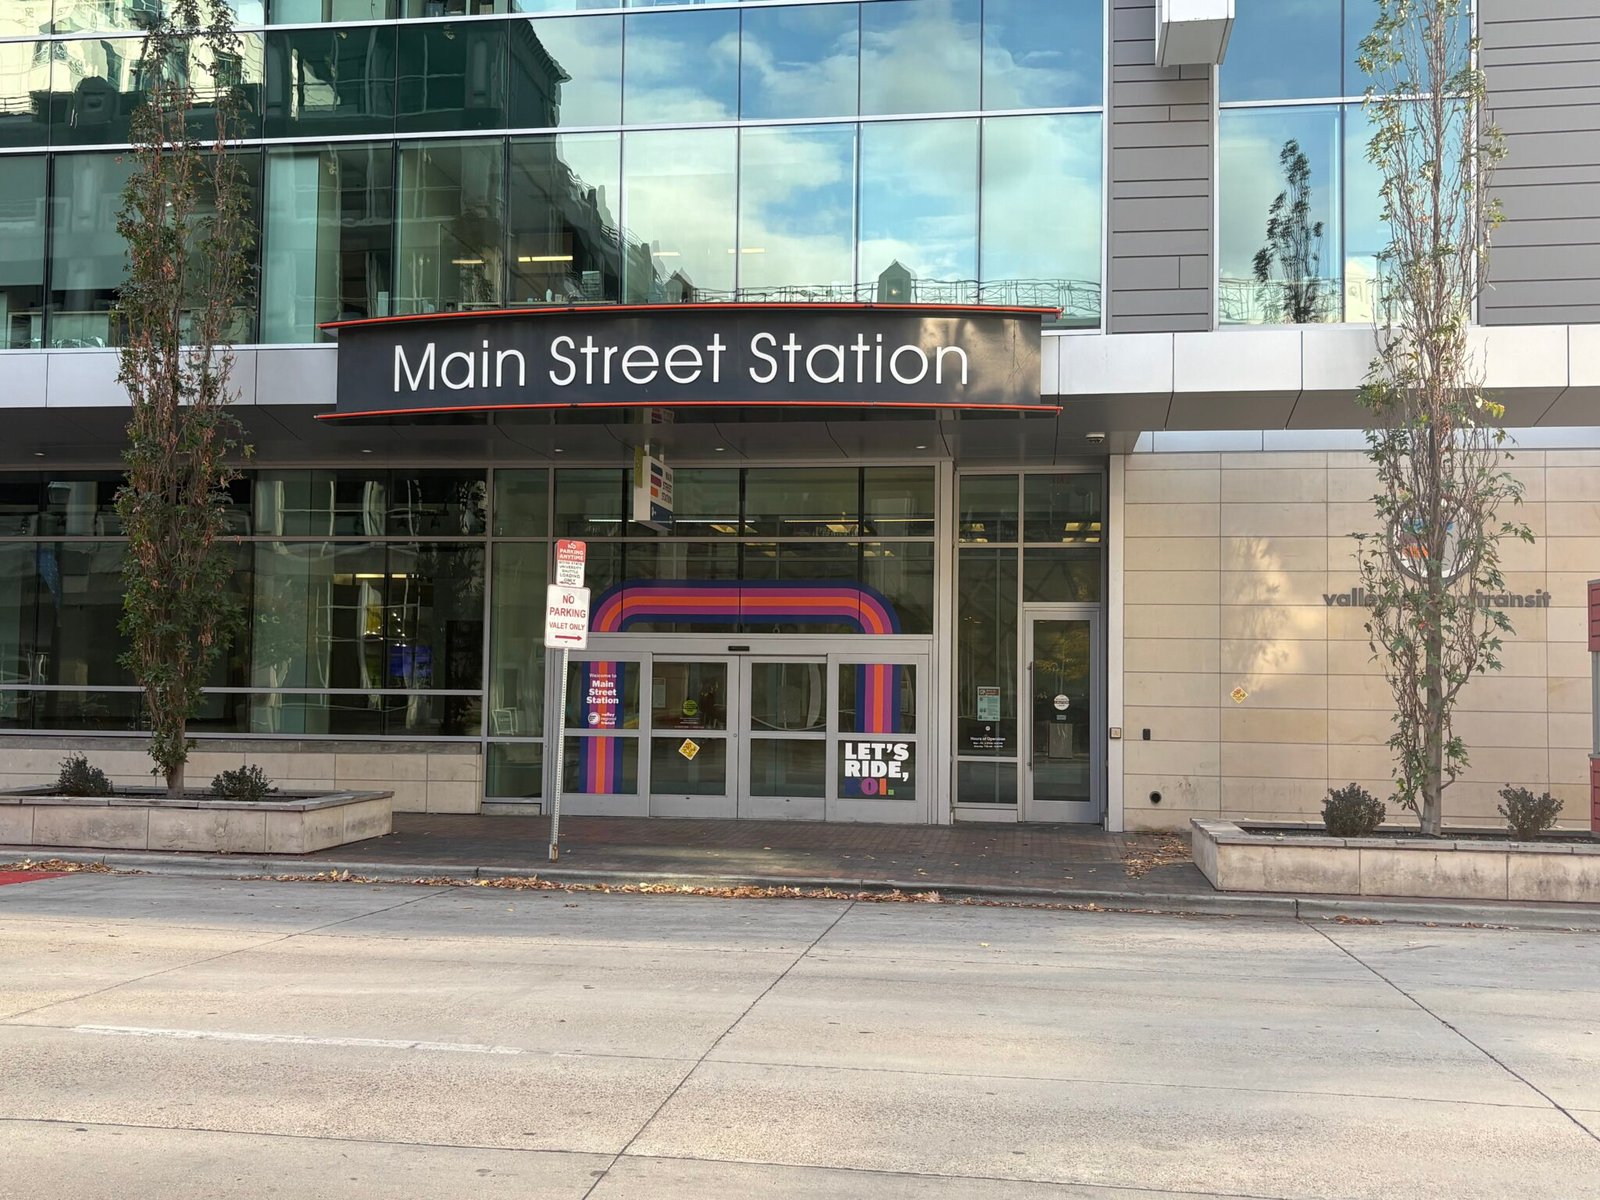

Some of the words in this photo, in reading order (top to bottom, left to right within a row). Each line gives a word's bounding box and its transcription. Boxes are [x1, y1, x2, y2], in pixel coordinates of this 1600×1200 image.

[393, 341, 526, 393] Main
[548, 332, 727, 387] Street
[748, 331, 970, 386] Station
[559, 548, 584, 556] PARKING
[562, 594, 575, 604] NO
[1477, 589, 1551, 608] transit
[549, 607, 586, 618] PARKING
[549, 621, 568, 630] VALET
[569, 623, 585, 631] ONLY
[592, 680, 614, 688] Main
[589, 688, 617, 696] Street
[586, 696, 619, 704] Station
[845, 743, 909, 760] LET’S
[845, 760, 909, 782] RIDE,
